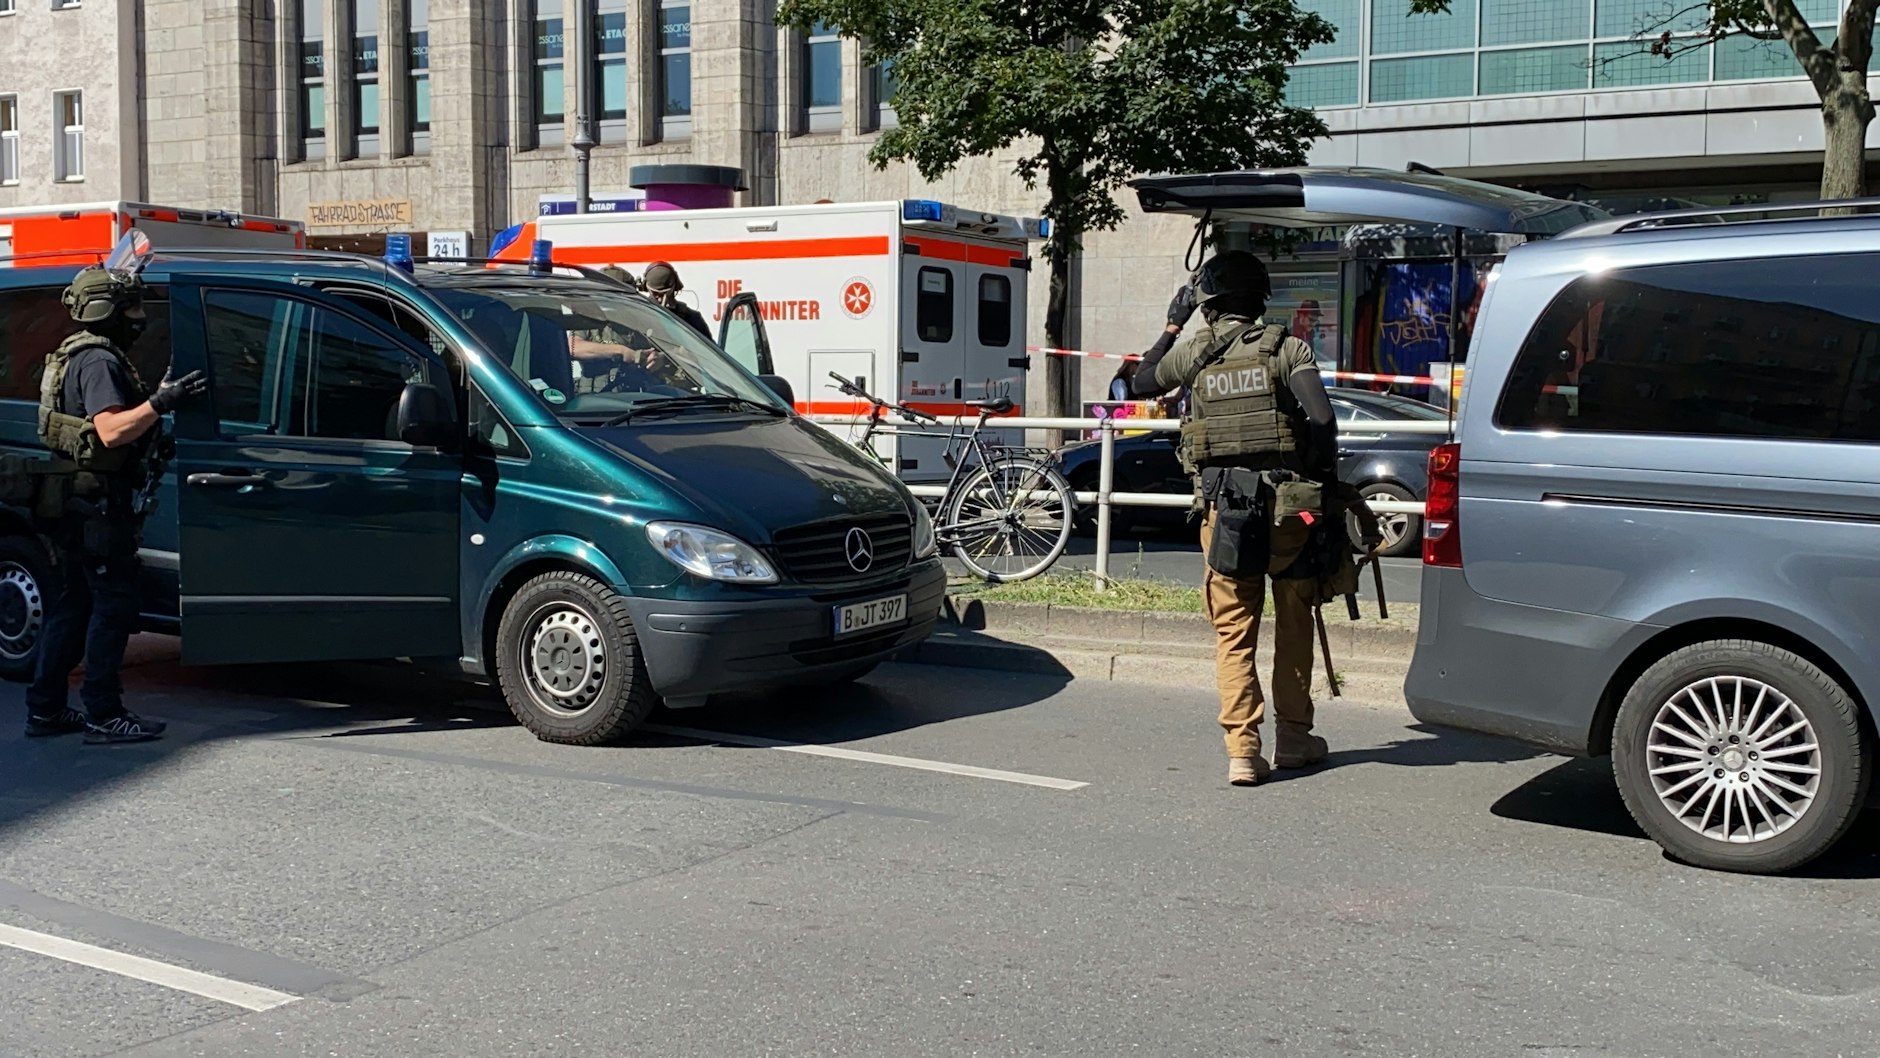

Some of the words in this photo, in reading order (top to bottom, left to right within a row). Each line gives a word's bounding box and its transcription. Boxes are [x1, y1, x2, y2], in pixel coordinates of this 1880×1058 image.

[309, 202, 407, 224] FAHRRADSTRASSE
[433, 236, 460, 244] Parkhaus
[434, 243, 448, 257] 24
[453, 243, 460, 257] h
[717, 279, 742, 299] DIE
[1289, 276, 1319, 288] meine
[713, 301, 820, 321] JHNNITER
[993, 381, 1010, 398] 112
[1206, 367, 1268, 397] POLIZEI
[844, 608, 853, 630] B
[861, 603, 877, 626] JT
[879, 597, 902, 622] 397
